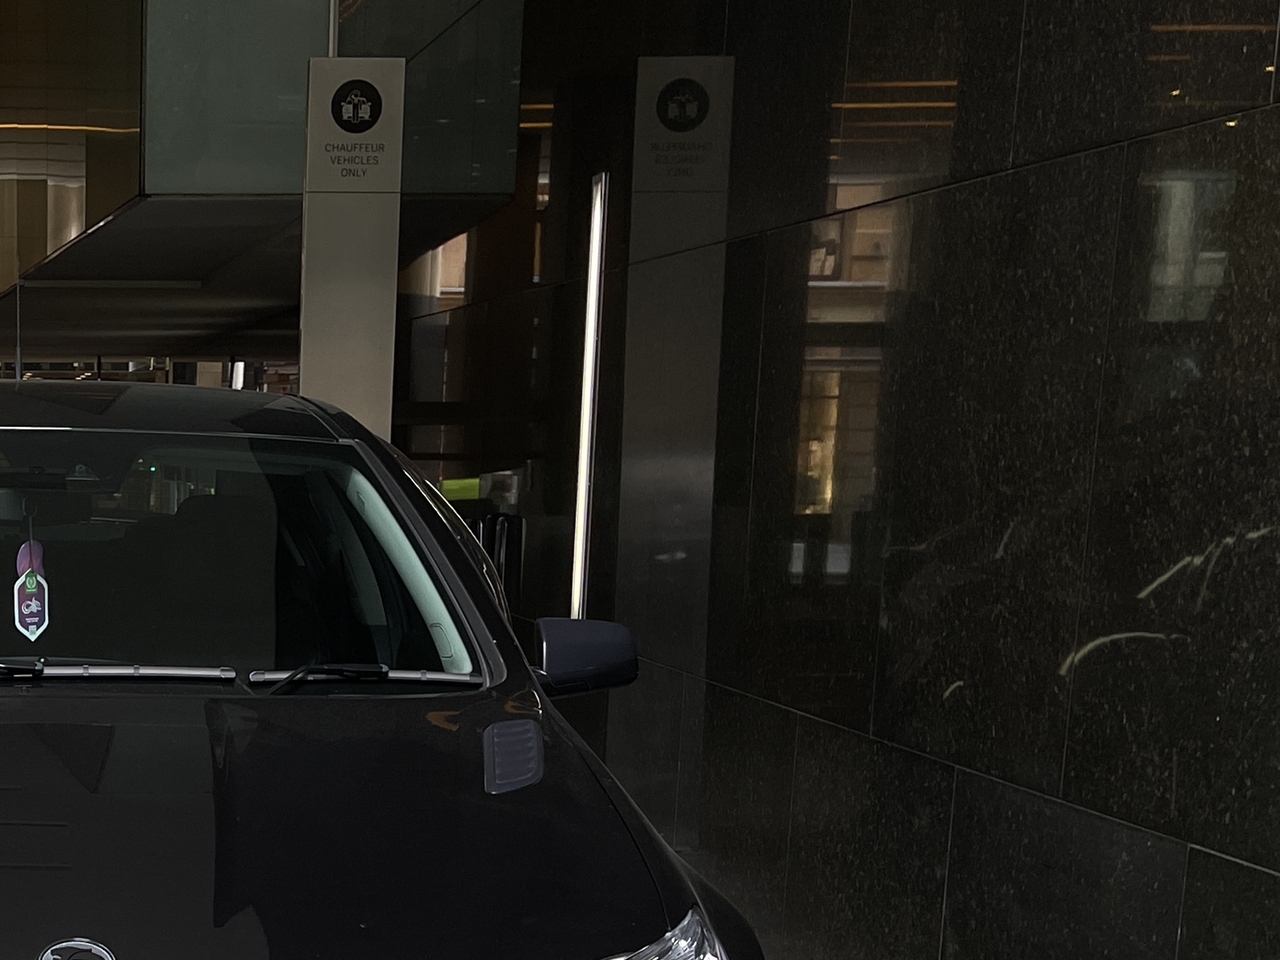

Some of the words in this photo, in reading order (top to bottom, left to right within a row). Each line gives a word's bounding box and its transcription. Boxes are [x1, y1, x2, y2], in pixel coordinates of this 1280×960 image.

[324, 143, 385, 153] CHAUFFEUR
[330, 155, 379, 165] VEHICLES
[340, 168, 368, 178] ONLY
